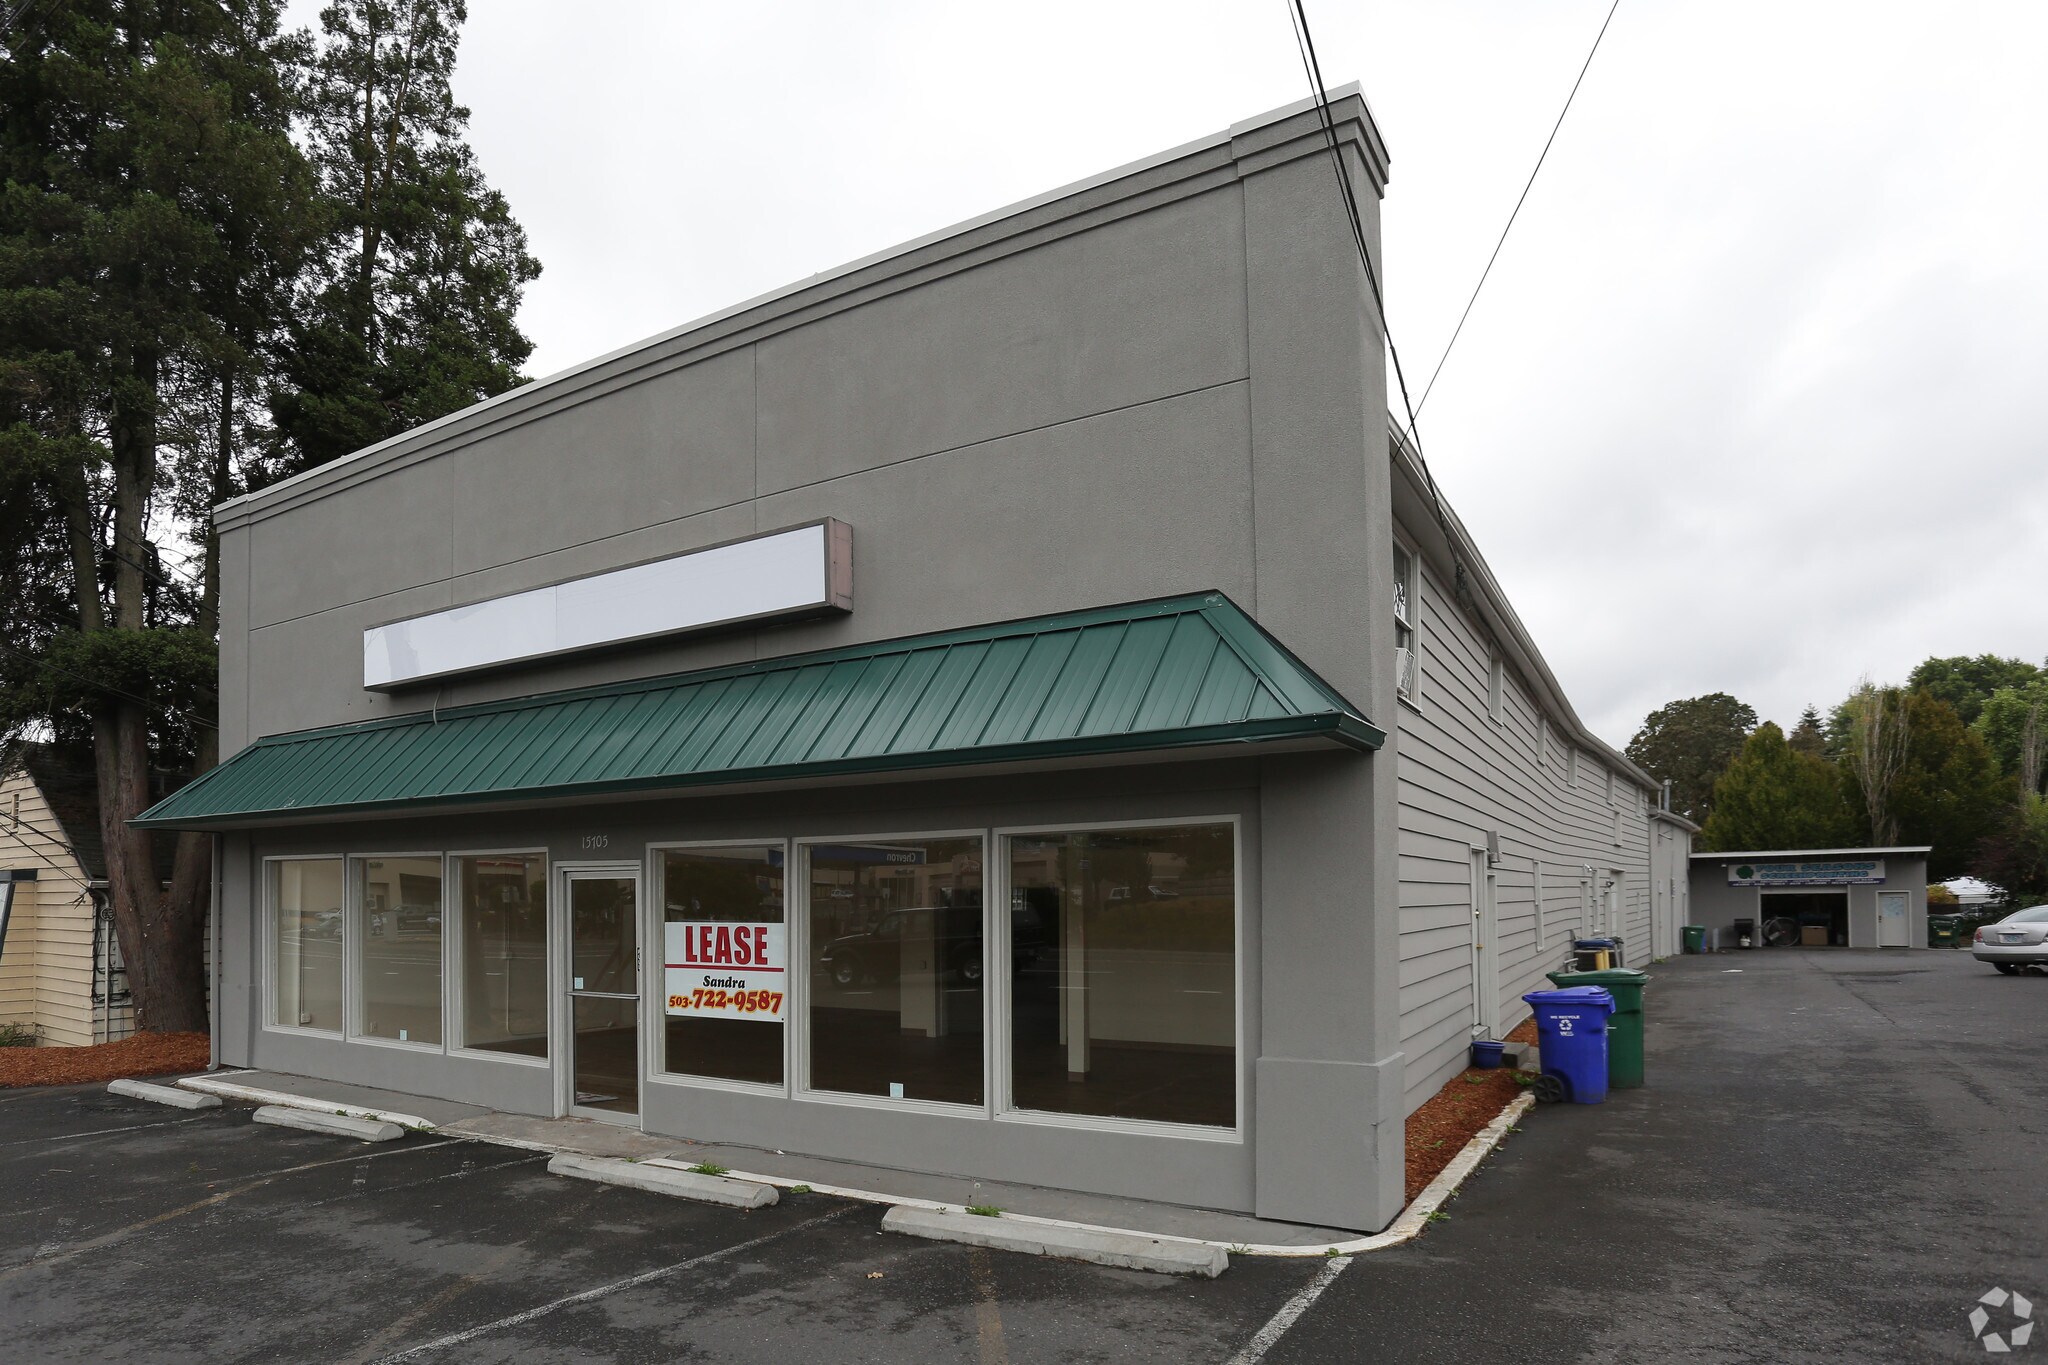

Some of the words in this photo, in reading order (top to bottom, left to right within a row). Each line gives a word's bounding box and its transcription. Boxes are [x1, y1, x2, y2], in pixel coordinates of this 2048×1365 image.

[1755, 864, 1797, 873] FOUR
[1801, 862, 1876, 871] SEASONS
[685, 925, 768, 965] LEASE
[702, 975, 746, 989] Sandra
[668, 989, 784, 1015] 503-722-9587
